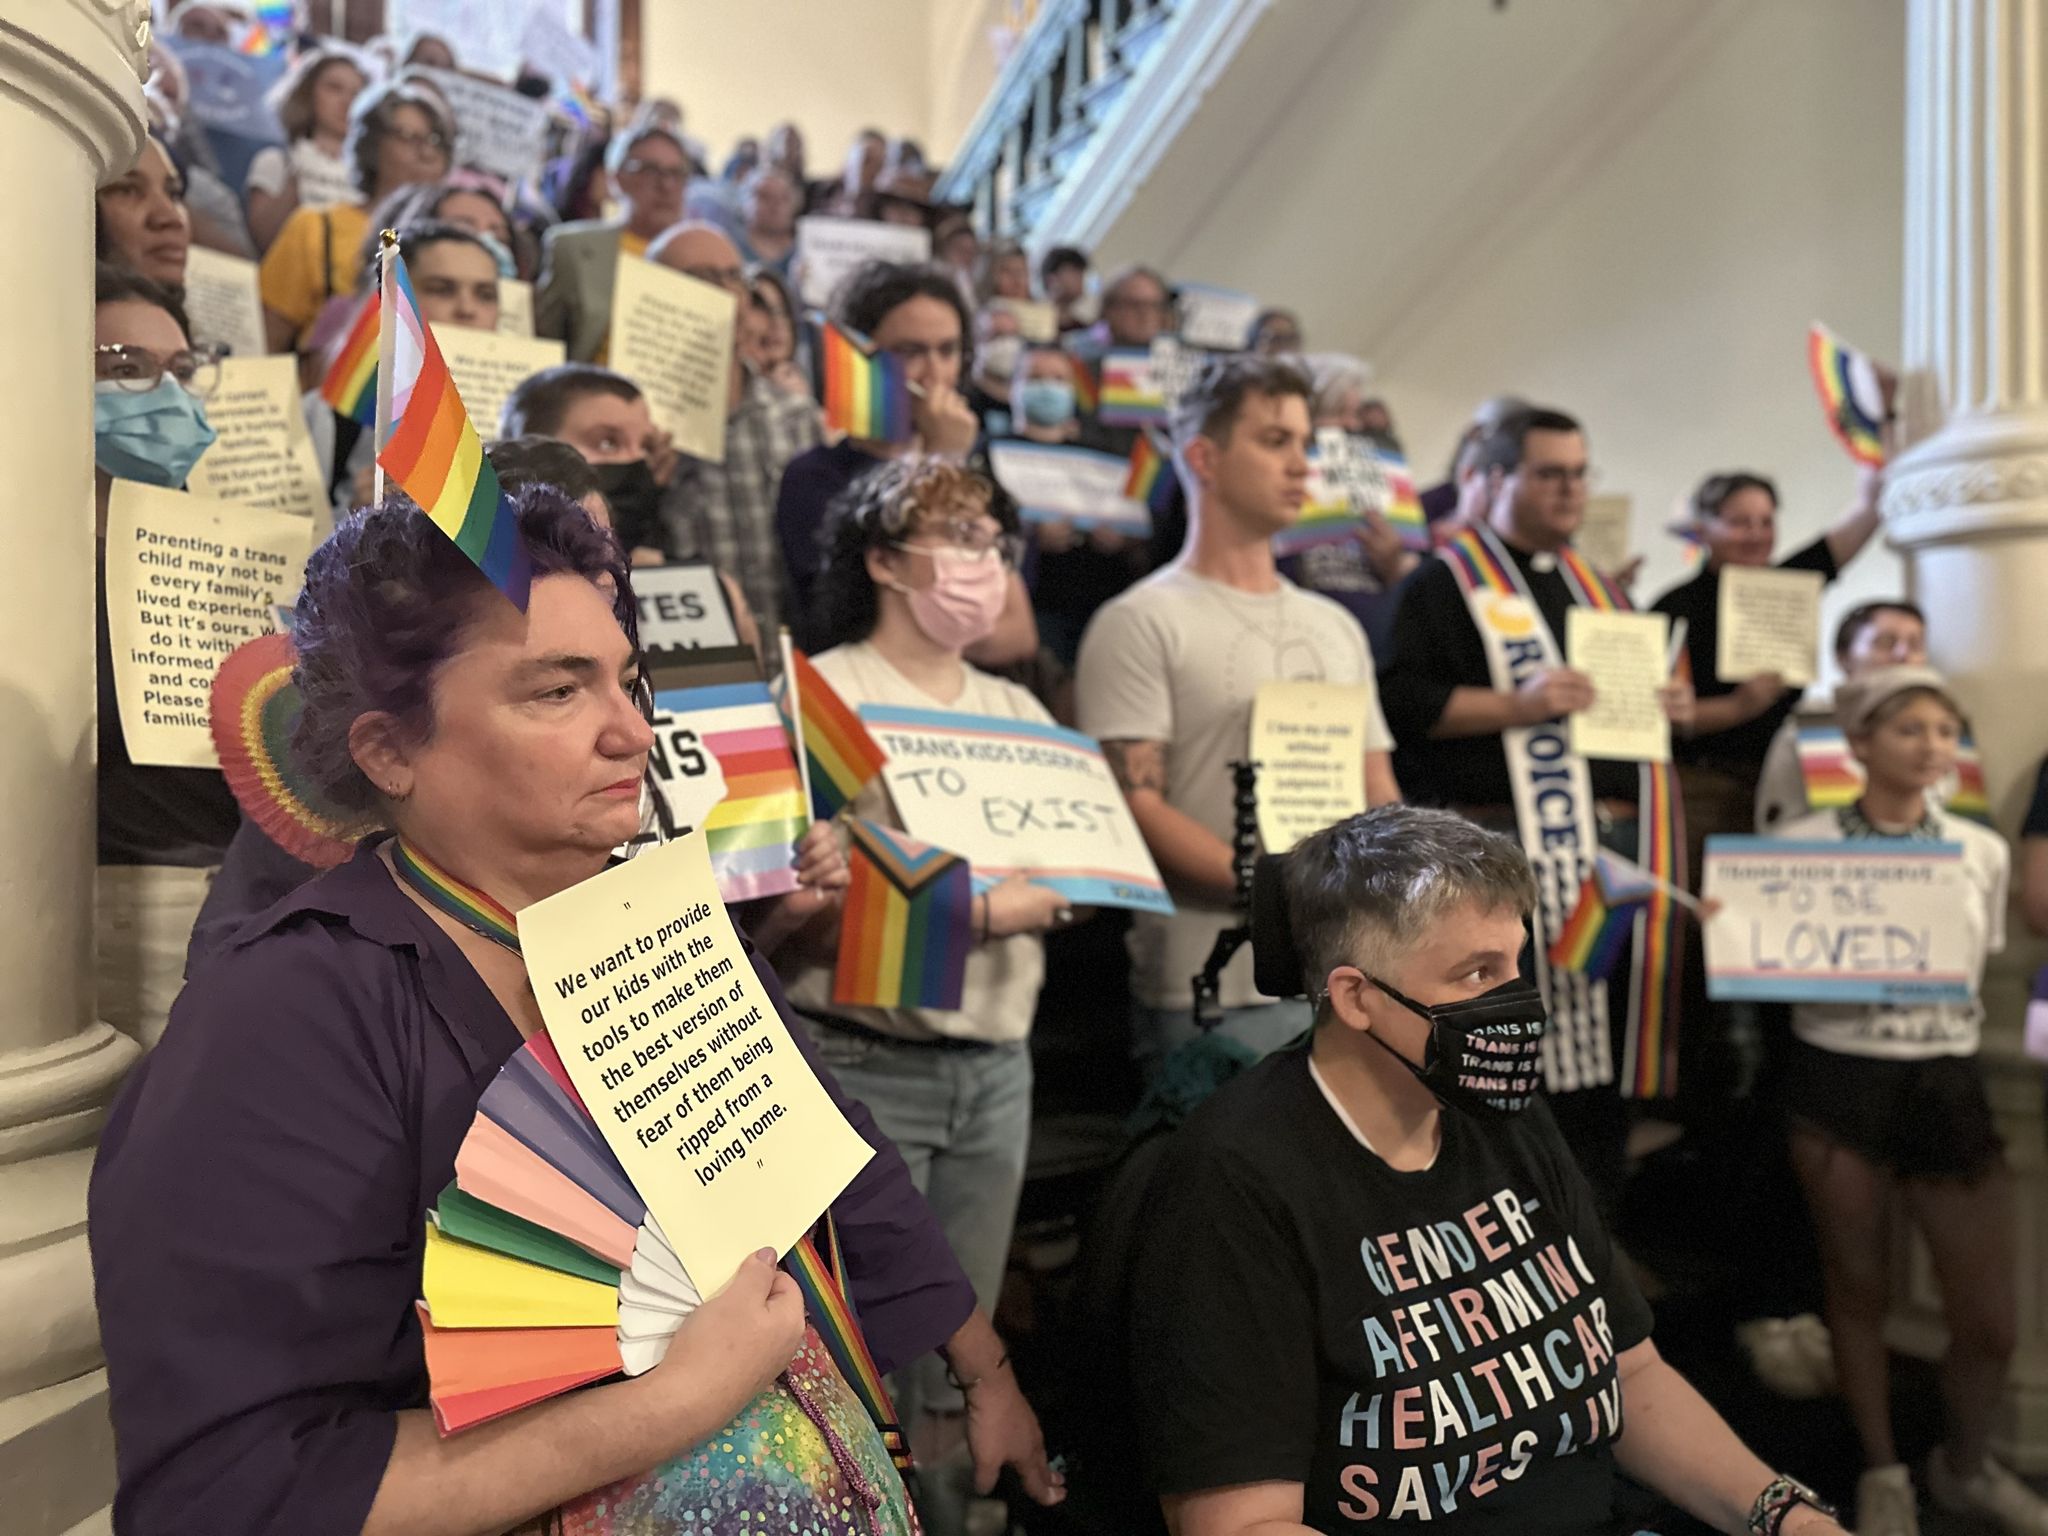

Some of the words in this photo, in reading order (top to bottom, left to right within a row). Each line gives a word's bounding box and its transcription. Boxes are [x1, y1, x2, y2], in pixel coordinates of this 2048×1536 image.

[136, 527, 223, 558] Parenting
[229, 547, 238, 558] a
[245, 547, 287, 566] trans
[138, 550, 182, 568] child
[189, 560, 225, 578] may
[231, 567, 258, 581] not
[264, 569, 283, 585] be
[137, 589, 180, 608] lived
[187, 599, 272, 620] experienc
[150, 574, 200, 594] every
[141, 610, 172, 627] But
[150, 632, 172, 647] do
[179, 634, 191, 649] it
[131, 648, 213, 669] informed
[149, 673, 182, 687] and
[144, 690, 203, 708] Please
[1504, 639, 1580, 852] ROICE
[896, 767, 966, 797] TO
[981, 796, 1122, 847] EXIST
[554, 973, 587, 999] We
[590, 944, 635, 980] want
[636, 936, 653, 954] to
[657, 903, 711, 947] provide
[1751, 919, 1931, 972] LOVED!
[581, 996, 610, 1024] our
[613, 973, 650, 1004] kids
[651, 950, 687, 980] with
[688, 935, 714, 957] the
[582, 1025, 629, 1062] tools
[629, 1012, 649, 1031] to
[652, 983, 695, 1018] make
[694, 958, 733, 988] them
[601, 1062, 634, 1090] the
[632, 1032, 673, 1068] best
[672, 996, 728, 1040] version
[729, 979, 744, 1002] of
[613, 1048, 707, 1123] themselves
[707, 1006, 762, 1053] without
[1461, 1053, 1514, 1073] TRANS
[1465, 1034, 1520, 1055] TRANS
[636, 1113, 673, 1149] fear
[676, 1093, 693, 1118] of
[692, 1067, 734, 1103] them
[731, 1036, 773, 1072] being
[1458, 1074, 1507, 1092] TRANS
[676, 1108, 727, 1161] ripped
[725, 1083, 762, 1117] from
[761, 1074, 773, 1088] a
[694, 1139, 746, 1186] loving
[741, 1104, 787, 1144] home.
[1360, 1188, 1541, 1296] GENDER-
[1339, 1297, 1614, 1450] HEALTHCAR
[1338, 1430, 1538, 1520] SAVES
[1554, 1378, 1621, 1457] LIV
